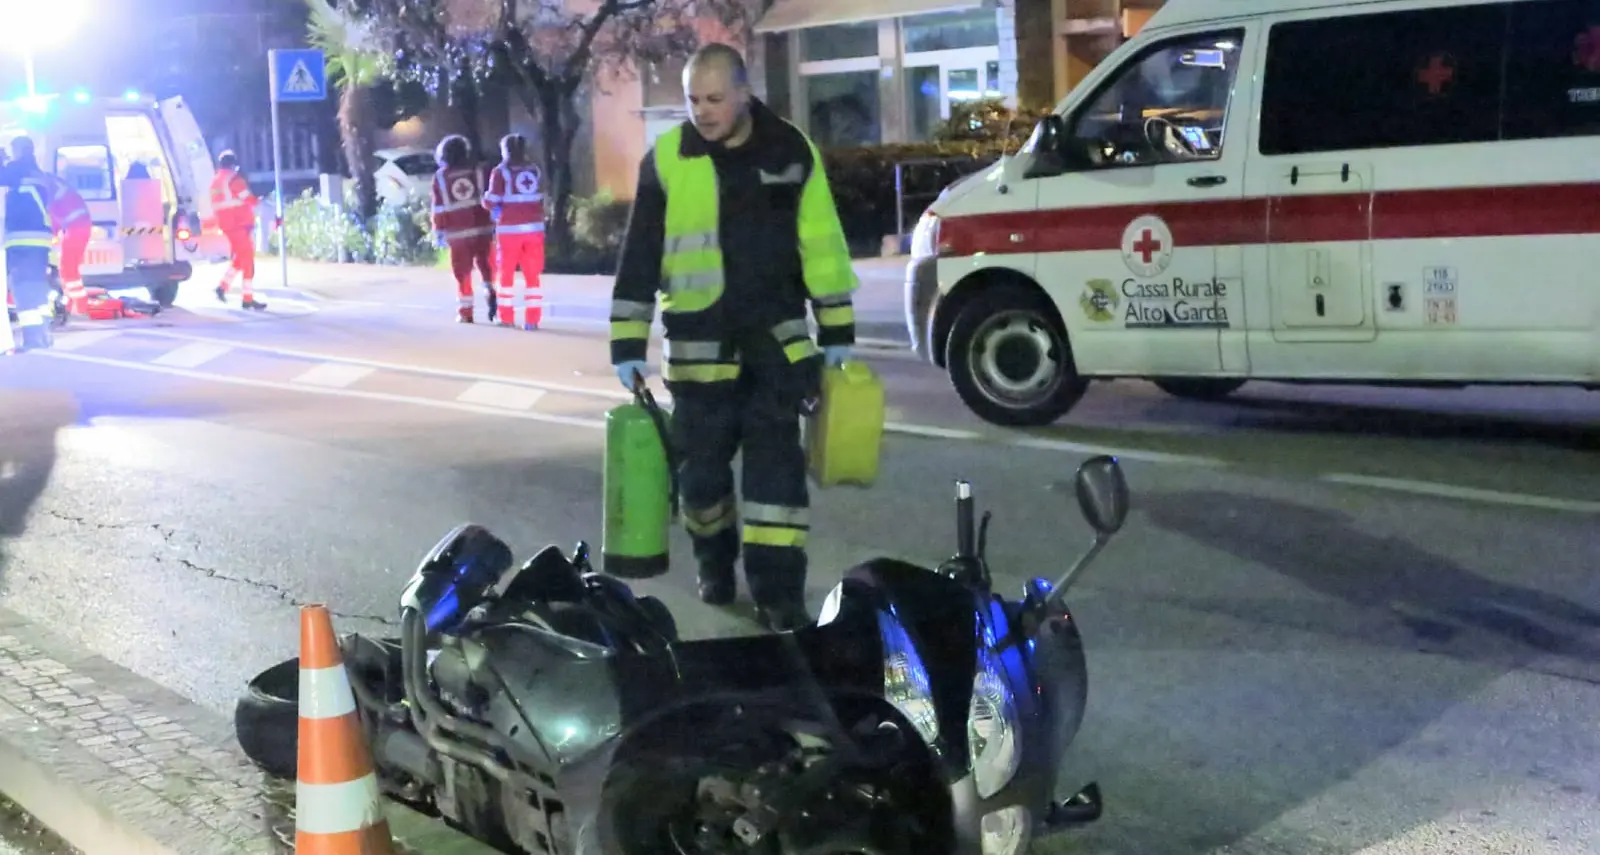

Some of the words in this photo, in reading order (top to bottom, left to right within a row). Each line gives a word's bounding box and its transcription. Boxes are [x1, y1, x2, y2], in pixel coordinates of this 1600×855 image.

[1122, 278, 1169, 298] Cassa
[1173, 277, 1227, 297] Rurale
[1125, 302, 1163, 321] Alto
[1174, 301, 1228, 321] Garda
